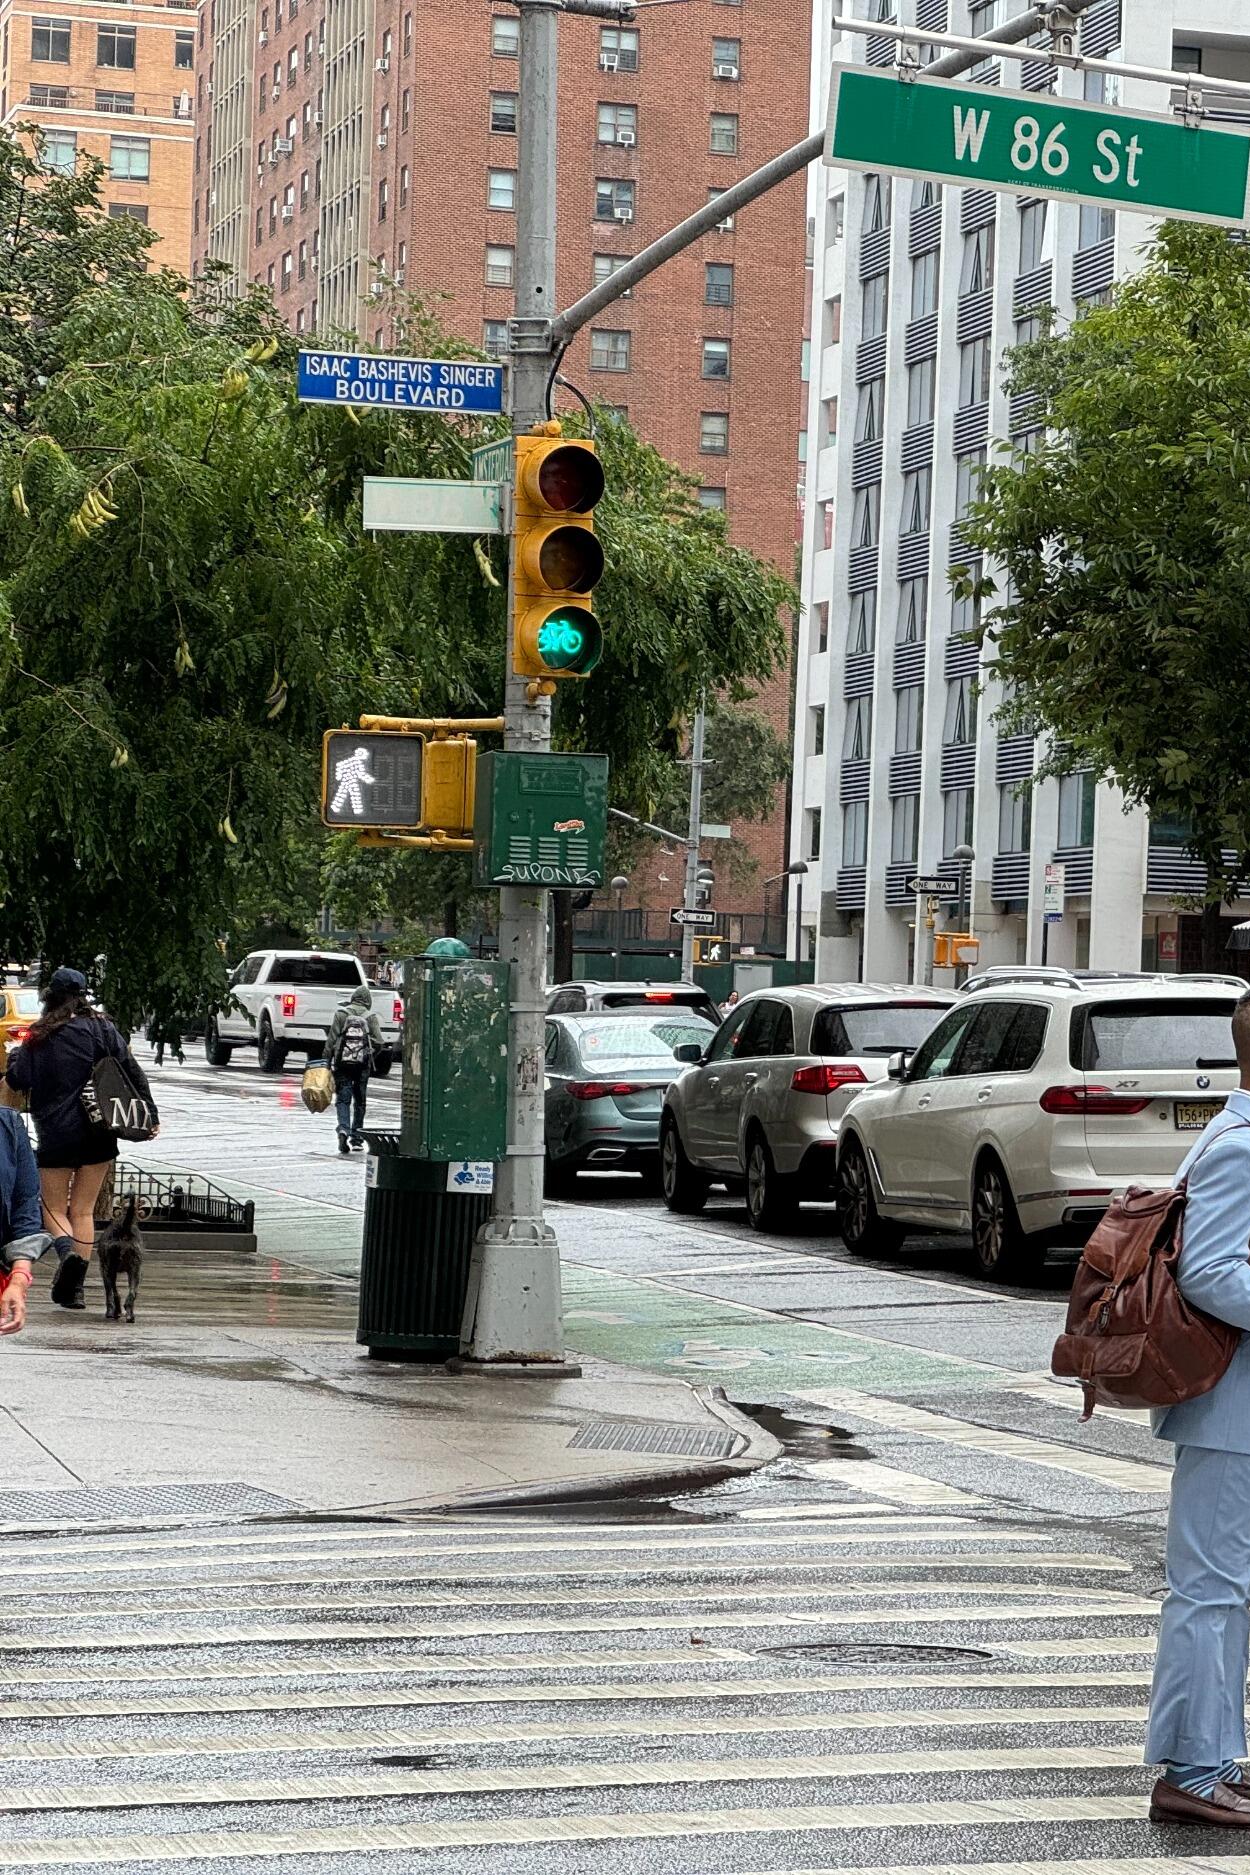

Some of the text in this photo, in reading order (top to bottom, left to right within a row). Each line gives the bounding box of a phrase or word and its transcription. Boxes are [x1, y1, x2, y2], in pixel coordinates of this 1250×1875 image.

[953, 105, 1143, 187] W 86 St
[305, 356, 496, 388] ISAAC BASHEVIS SINGER
[336, 380, 465, 407] BOULEVARD
[913, 881, 928, 889] ONE
[1115, 1080, 1140, 1088] X7
